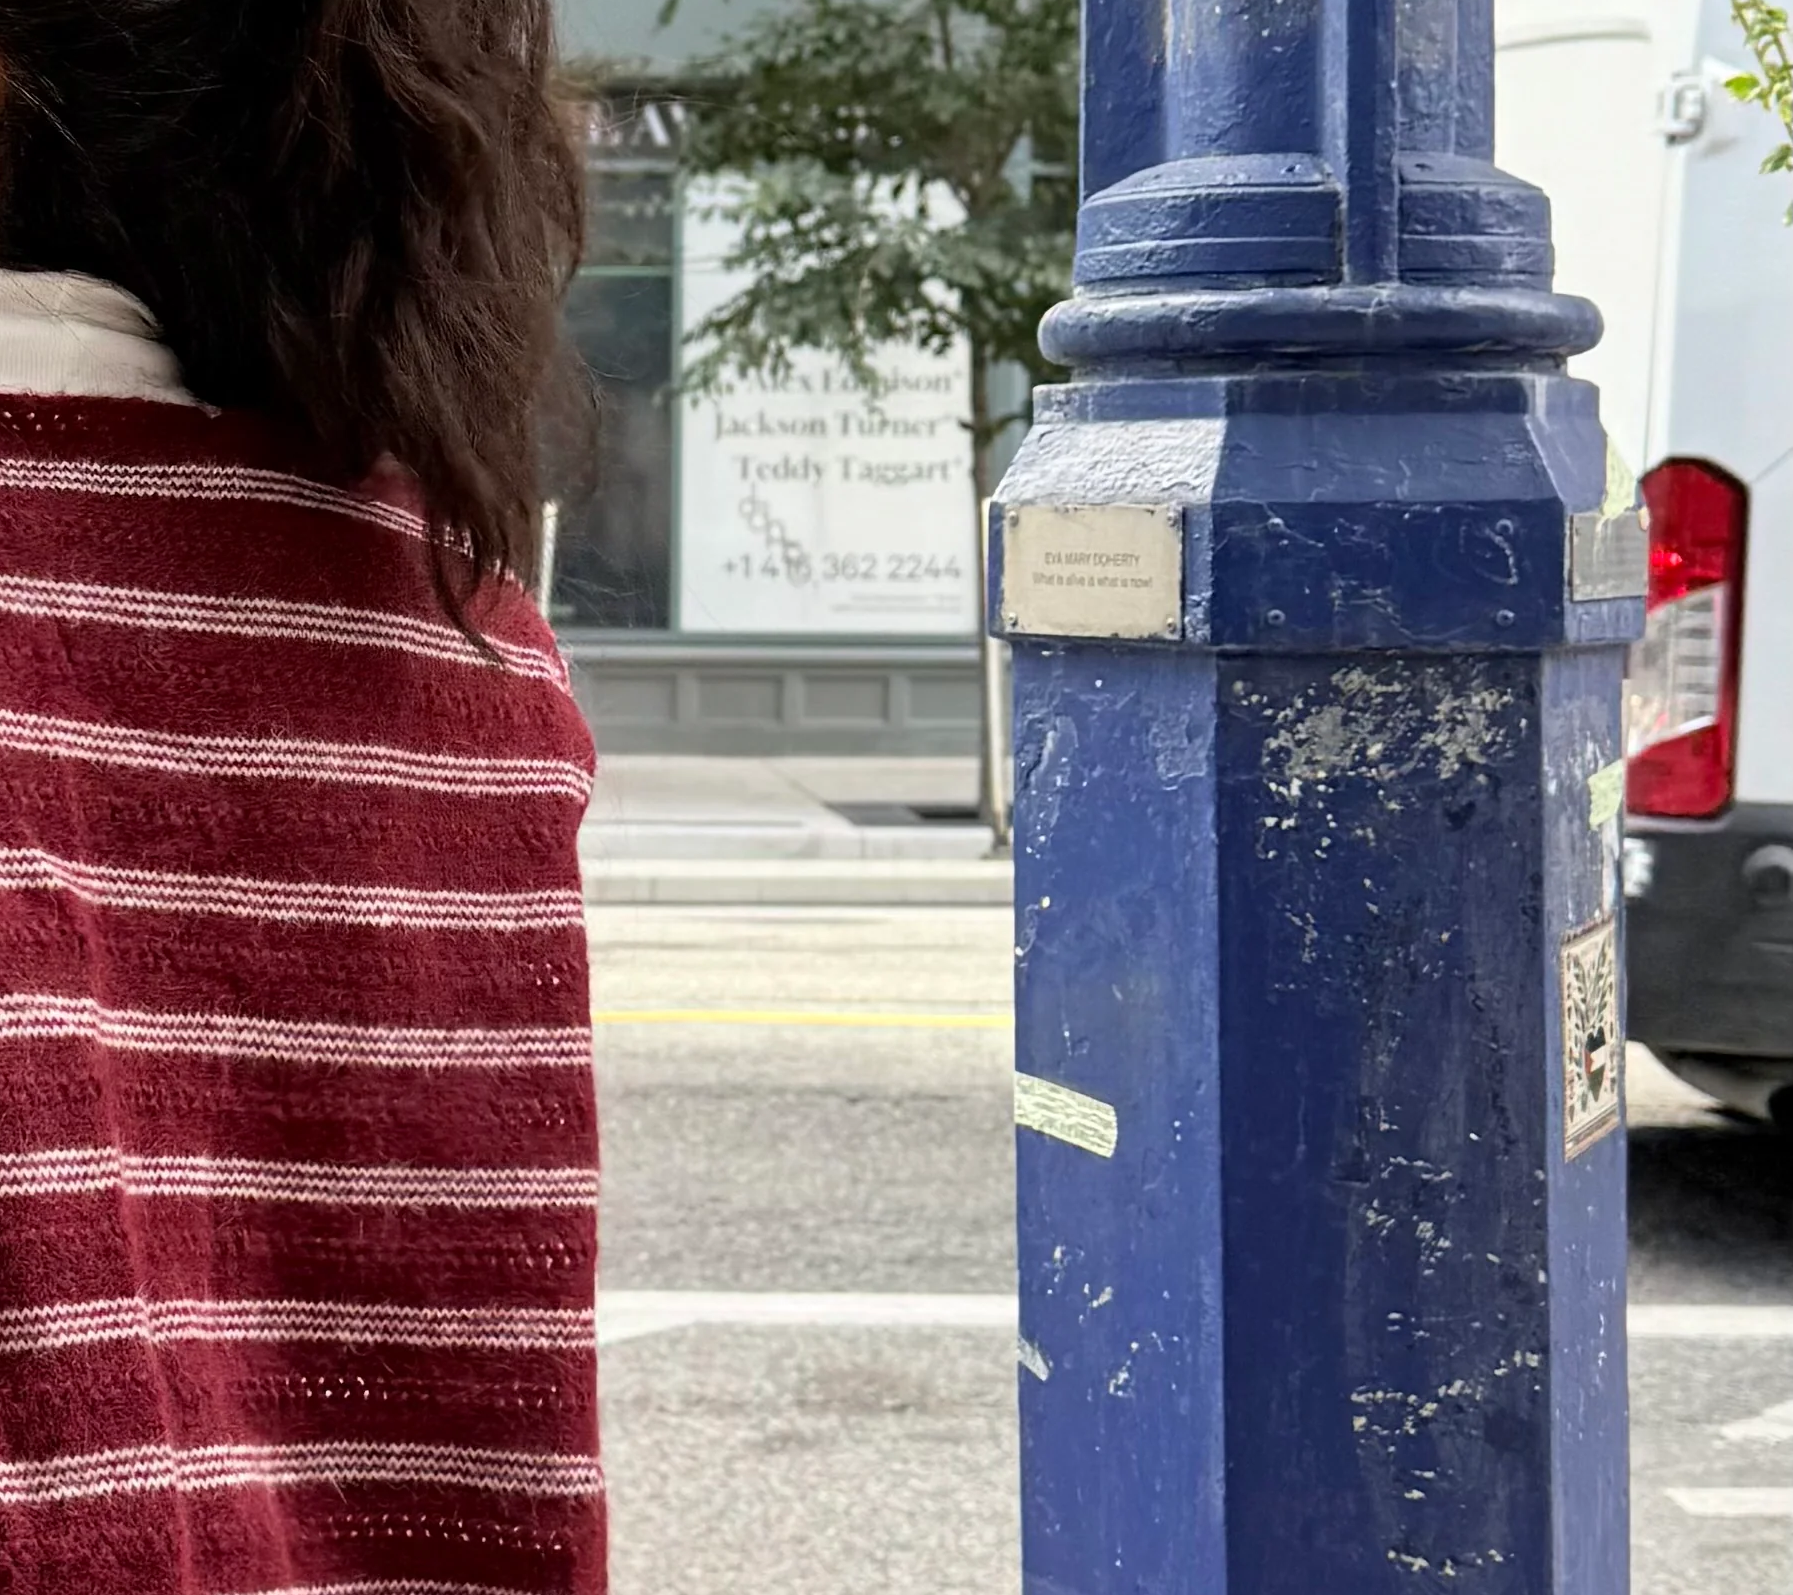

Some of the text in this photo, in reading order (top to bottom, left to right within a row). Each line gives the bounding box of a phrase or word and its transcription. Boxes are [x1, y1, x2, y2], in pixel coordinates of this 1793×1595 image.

[714, 411, 826, 440] Jackson
[733, 455, 824, 487] Teddy
[822, 553, 877, 581] 362
[888, 553, 962, 580] 2244
[1064, 551, 1091, 567] MARY
[1093, 552, 1141, 568] DOHERTY
